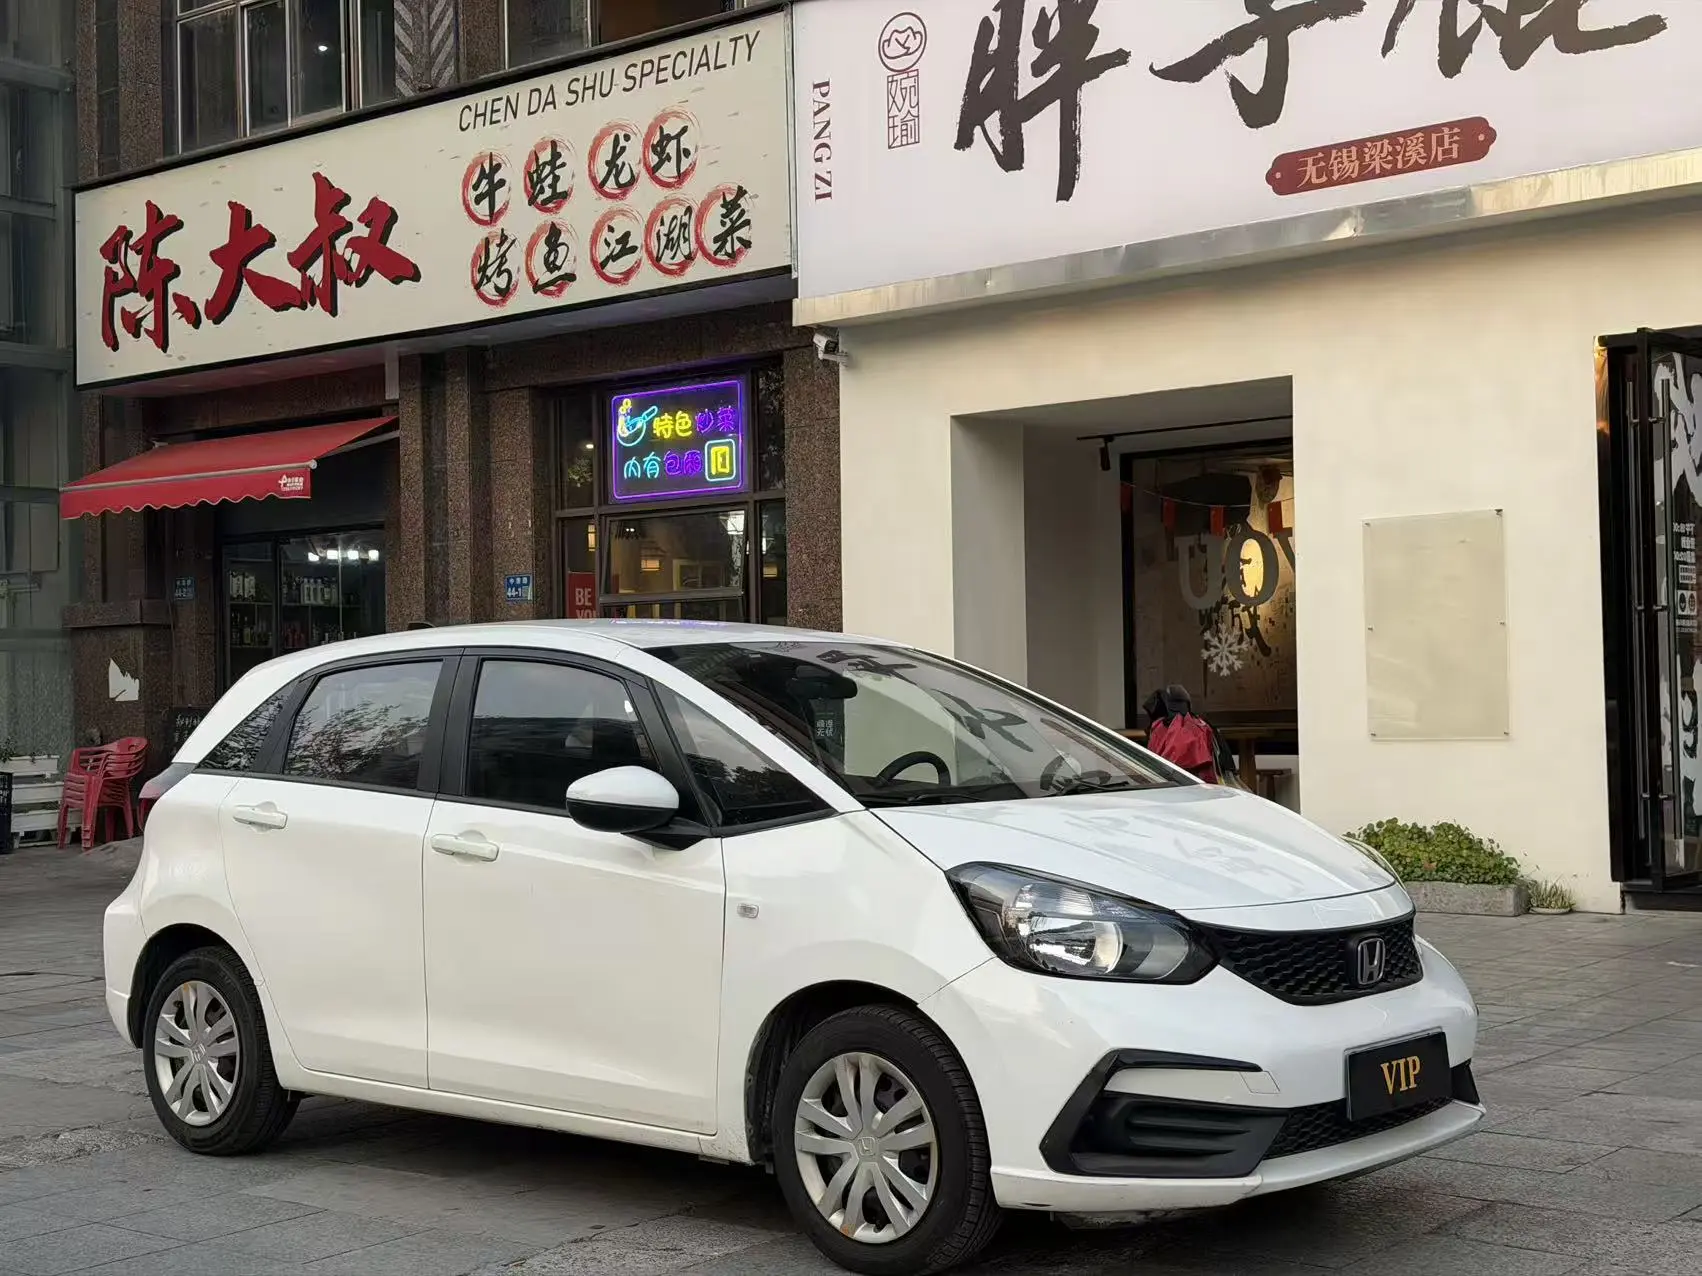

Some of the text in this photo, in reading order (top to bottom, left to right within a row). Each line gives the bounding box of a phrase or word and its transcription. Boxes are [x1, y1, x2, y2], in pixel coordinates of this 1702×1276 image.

[458, 30, 761, 133] CHEN DA SHU SPECIALTY
[812, 78, 833, 204] PANG ZI
[1296, 126, 1464, 189] 无锡梁溪店
[99, 171, 422, 353] 陈大叔
[506, 588, 523, 598] 44-1
[575, 588, 592, 606] BE
[1380, 1055, 1421, 1096] VIP
